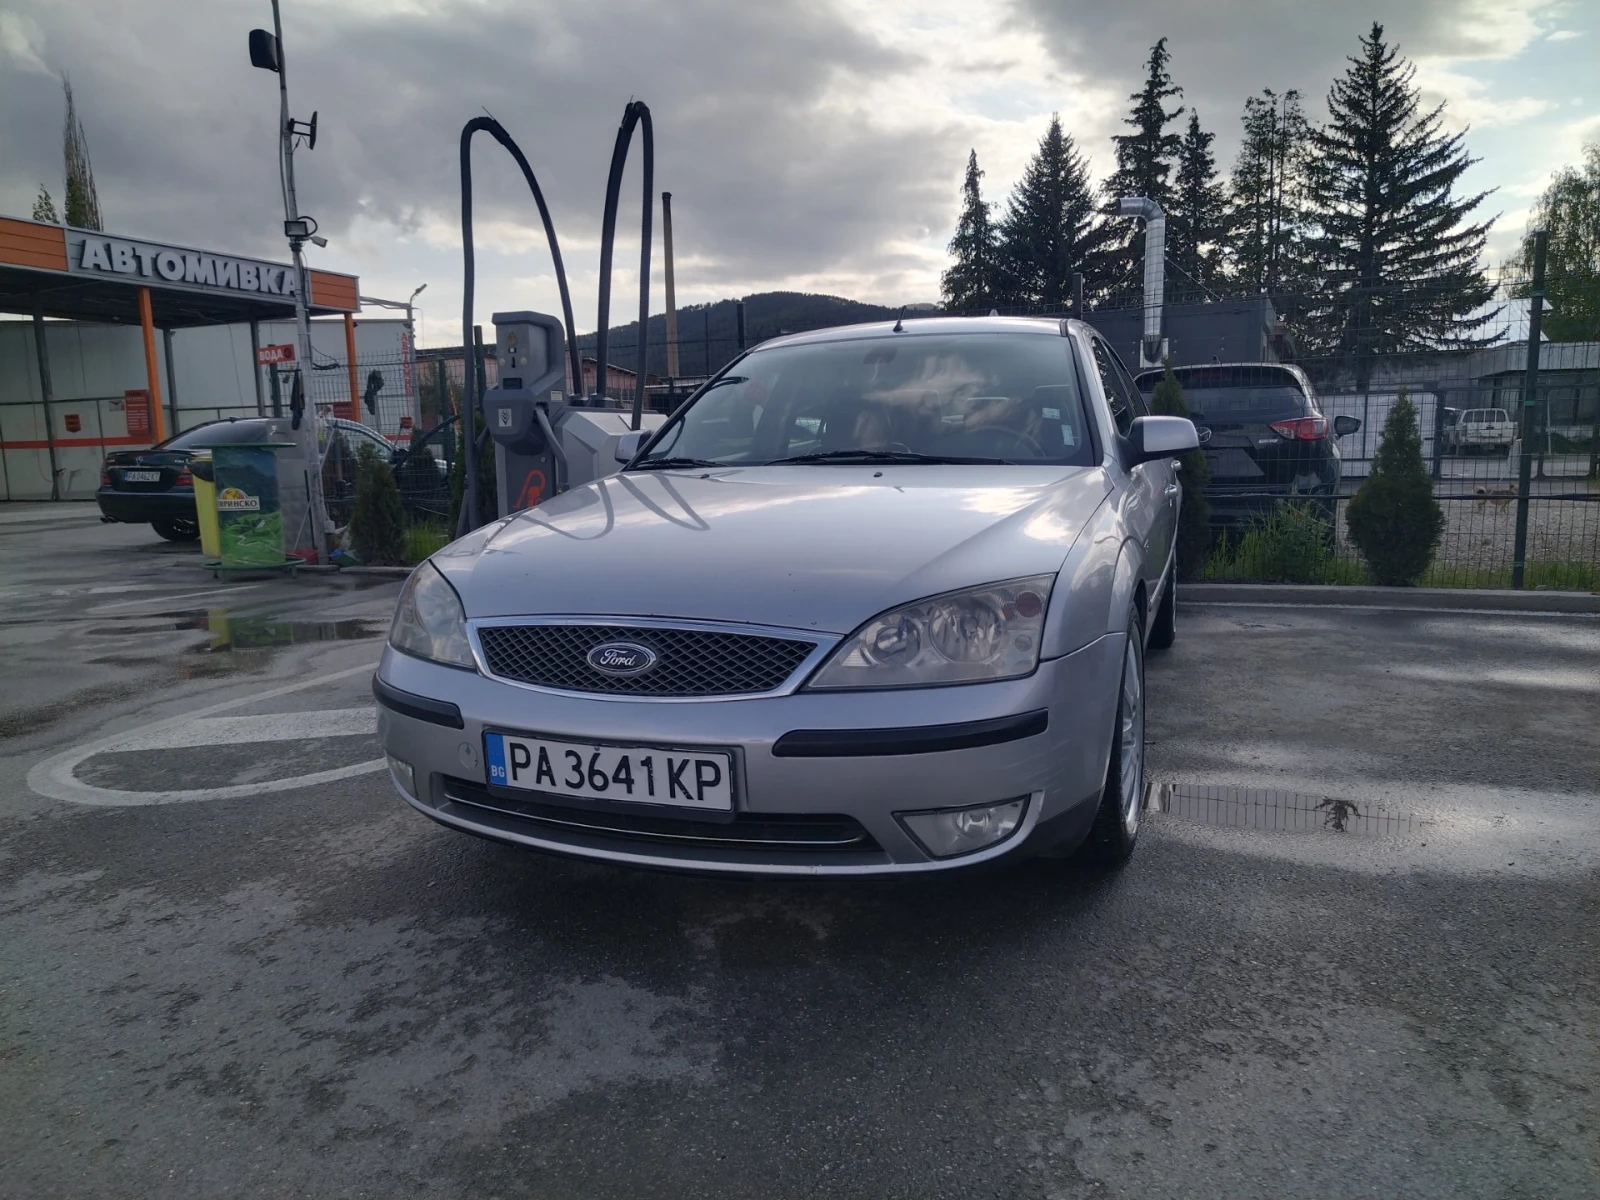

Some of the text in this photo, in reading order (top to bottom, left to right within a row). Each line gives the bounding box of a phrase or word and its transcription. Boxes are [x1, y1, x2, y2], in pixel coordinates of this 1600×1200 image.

[80, 238, 297, 297] АВТОМИВКА
[259, 349, 284, 361] ВОДА
[599, 648, 637, 666] Ford
[491, 764, 506, 778] BG
